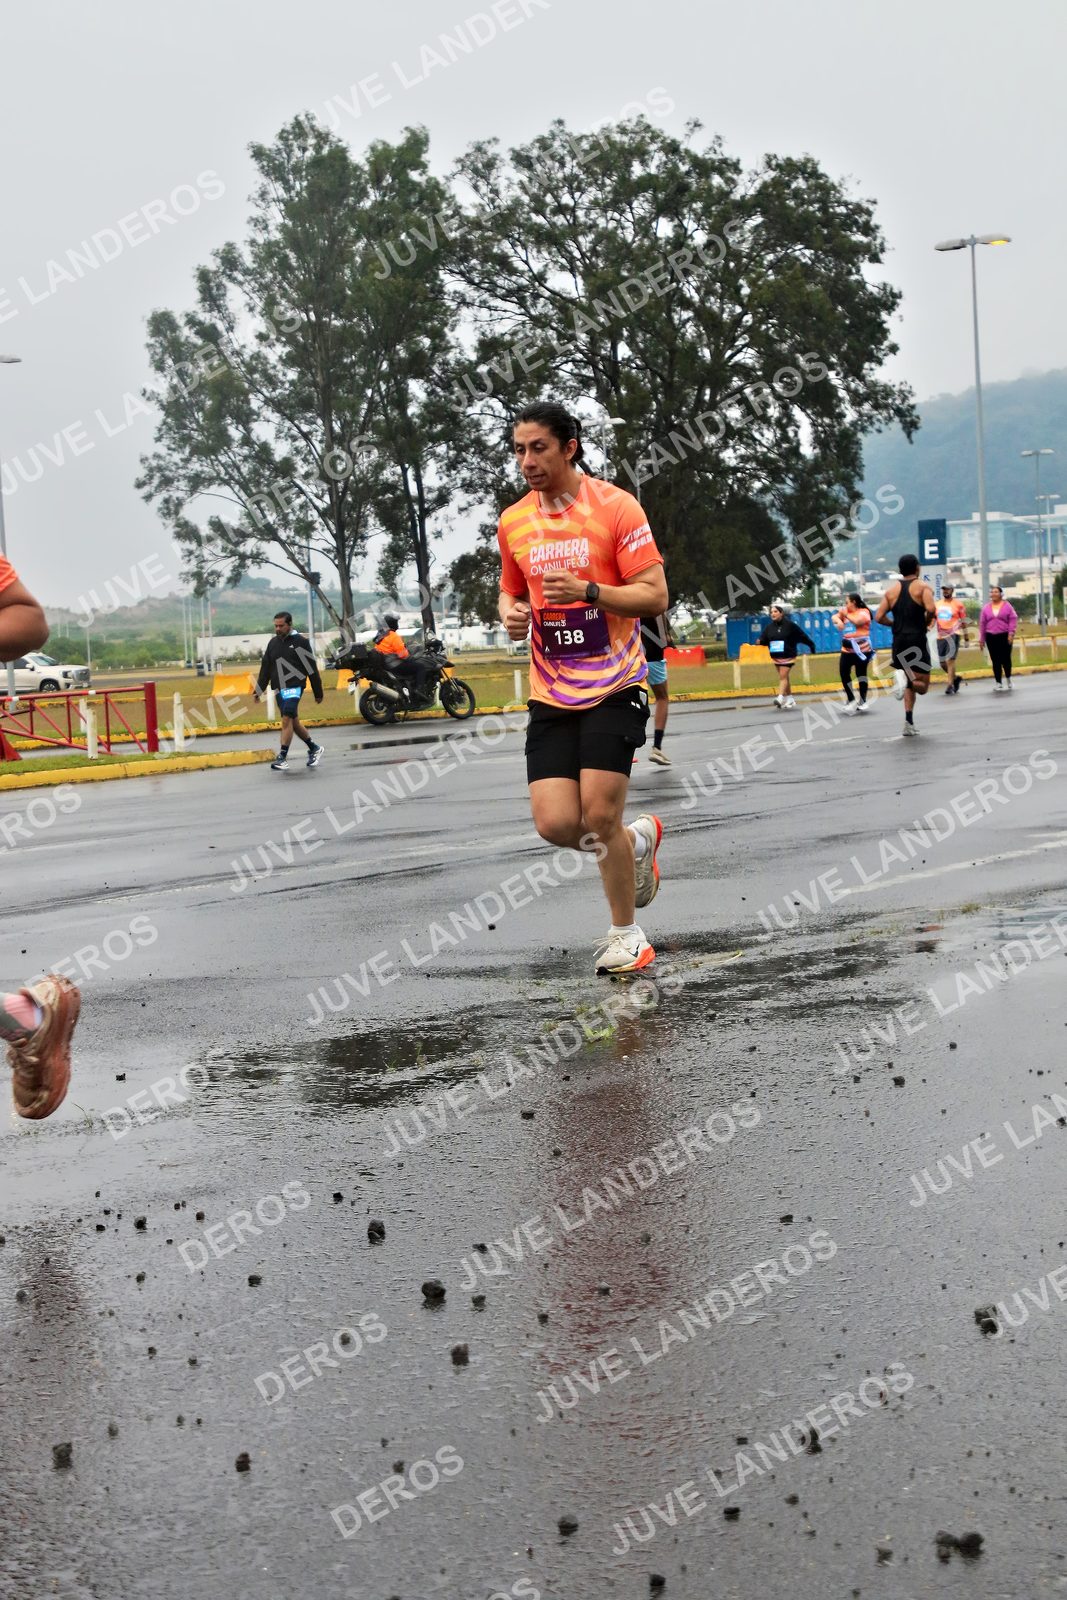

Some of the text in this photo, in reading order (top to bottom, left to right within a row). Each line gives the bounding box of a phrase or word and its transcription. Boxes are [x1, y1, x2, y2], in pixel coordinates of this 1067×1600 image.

[530, 538, 589, 563] CARRERA
[924, 538, 939, 560] E
[530, 558, 577, 576] OMNILIFE
[554, 629, 585, 645] 138
